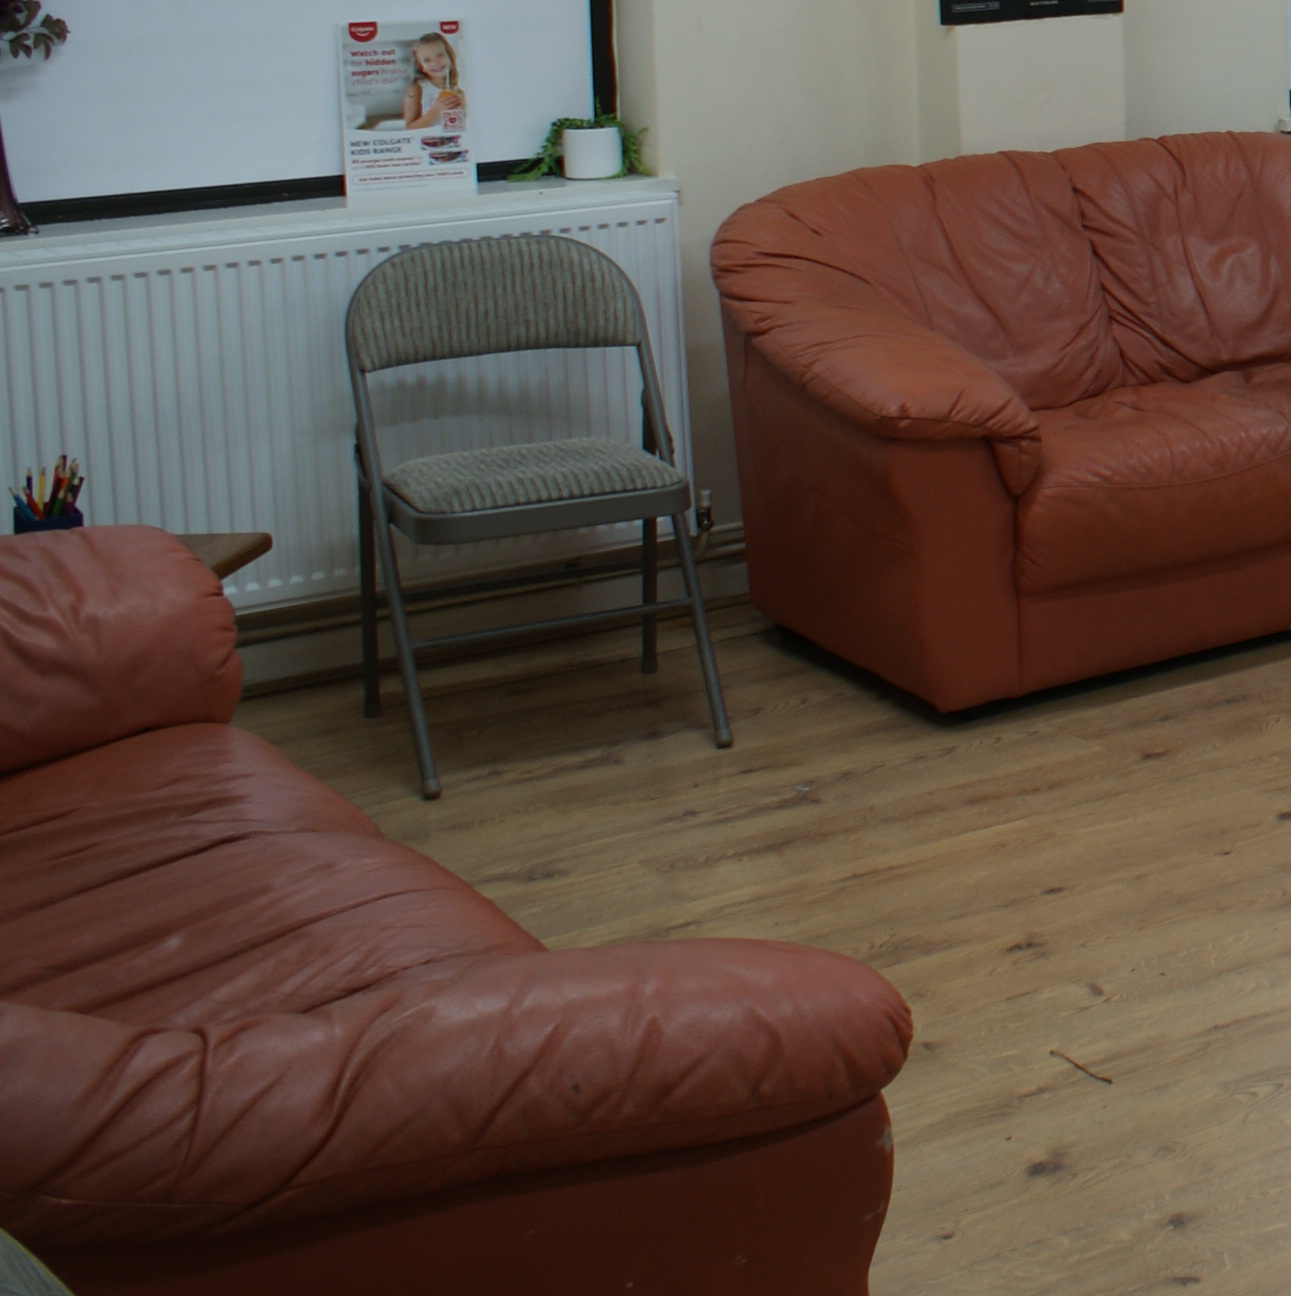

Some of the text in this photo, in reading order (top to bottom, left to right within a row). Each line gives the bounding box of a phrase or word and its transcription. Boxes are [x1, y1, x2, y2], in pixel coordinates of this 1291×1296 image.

[373, 138, 411, 146] COLGATE
[351, 146, 402, 156] KIDS RANGE
